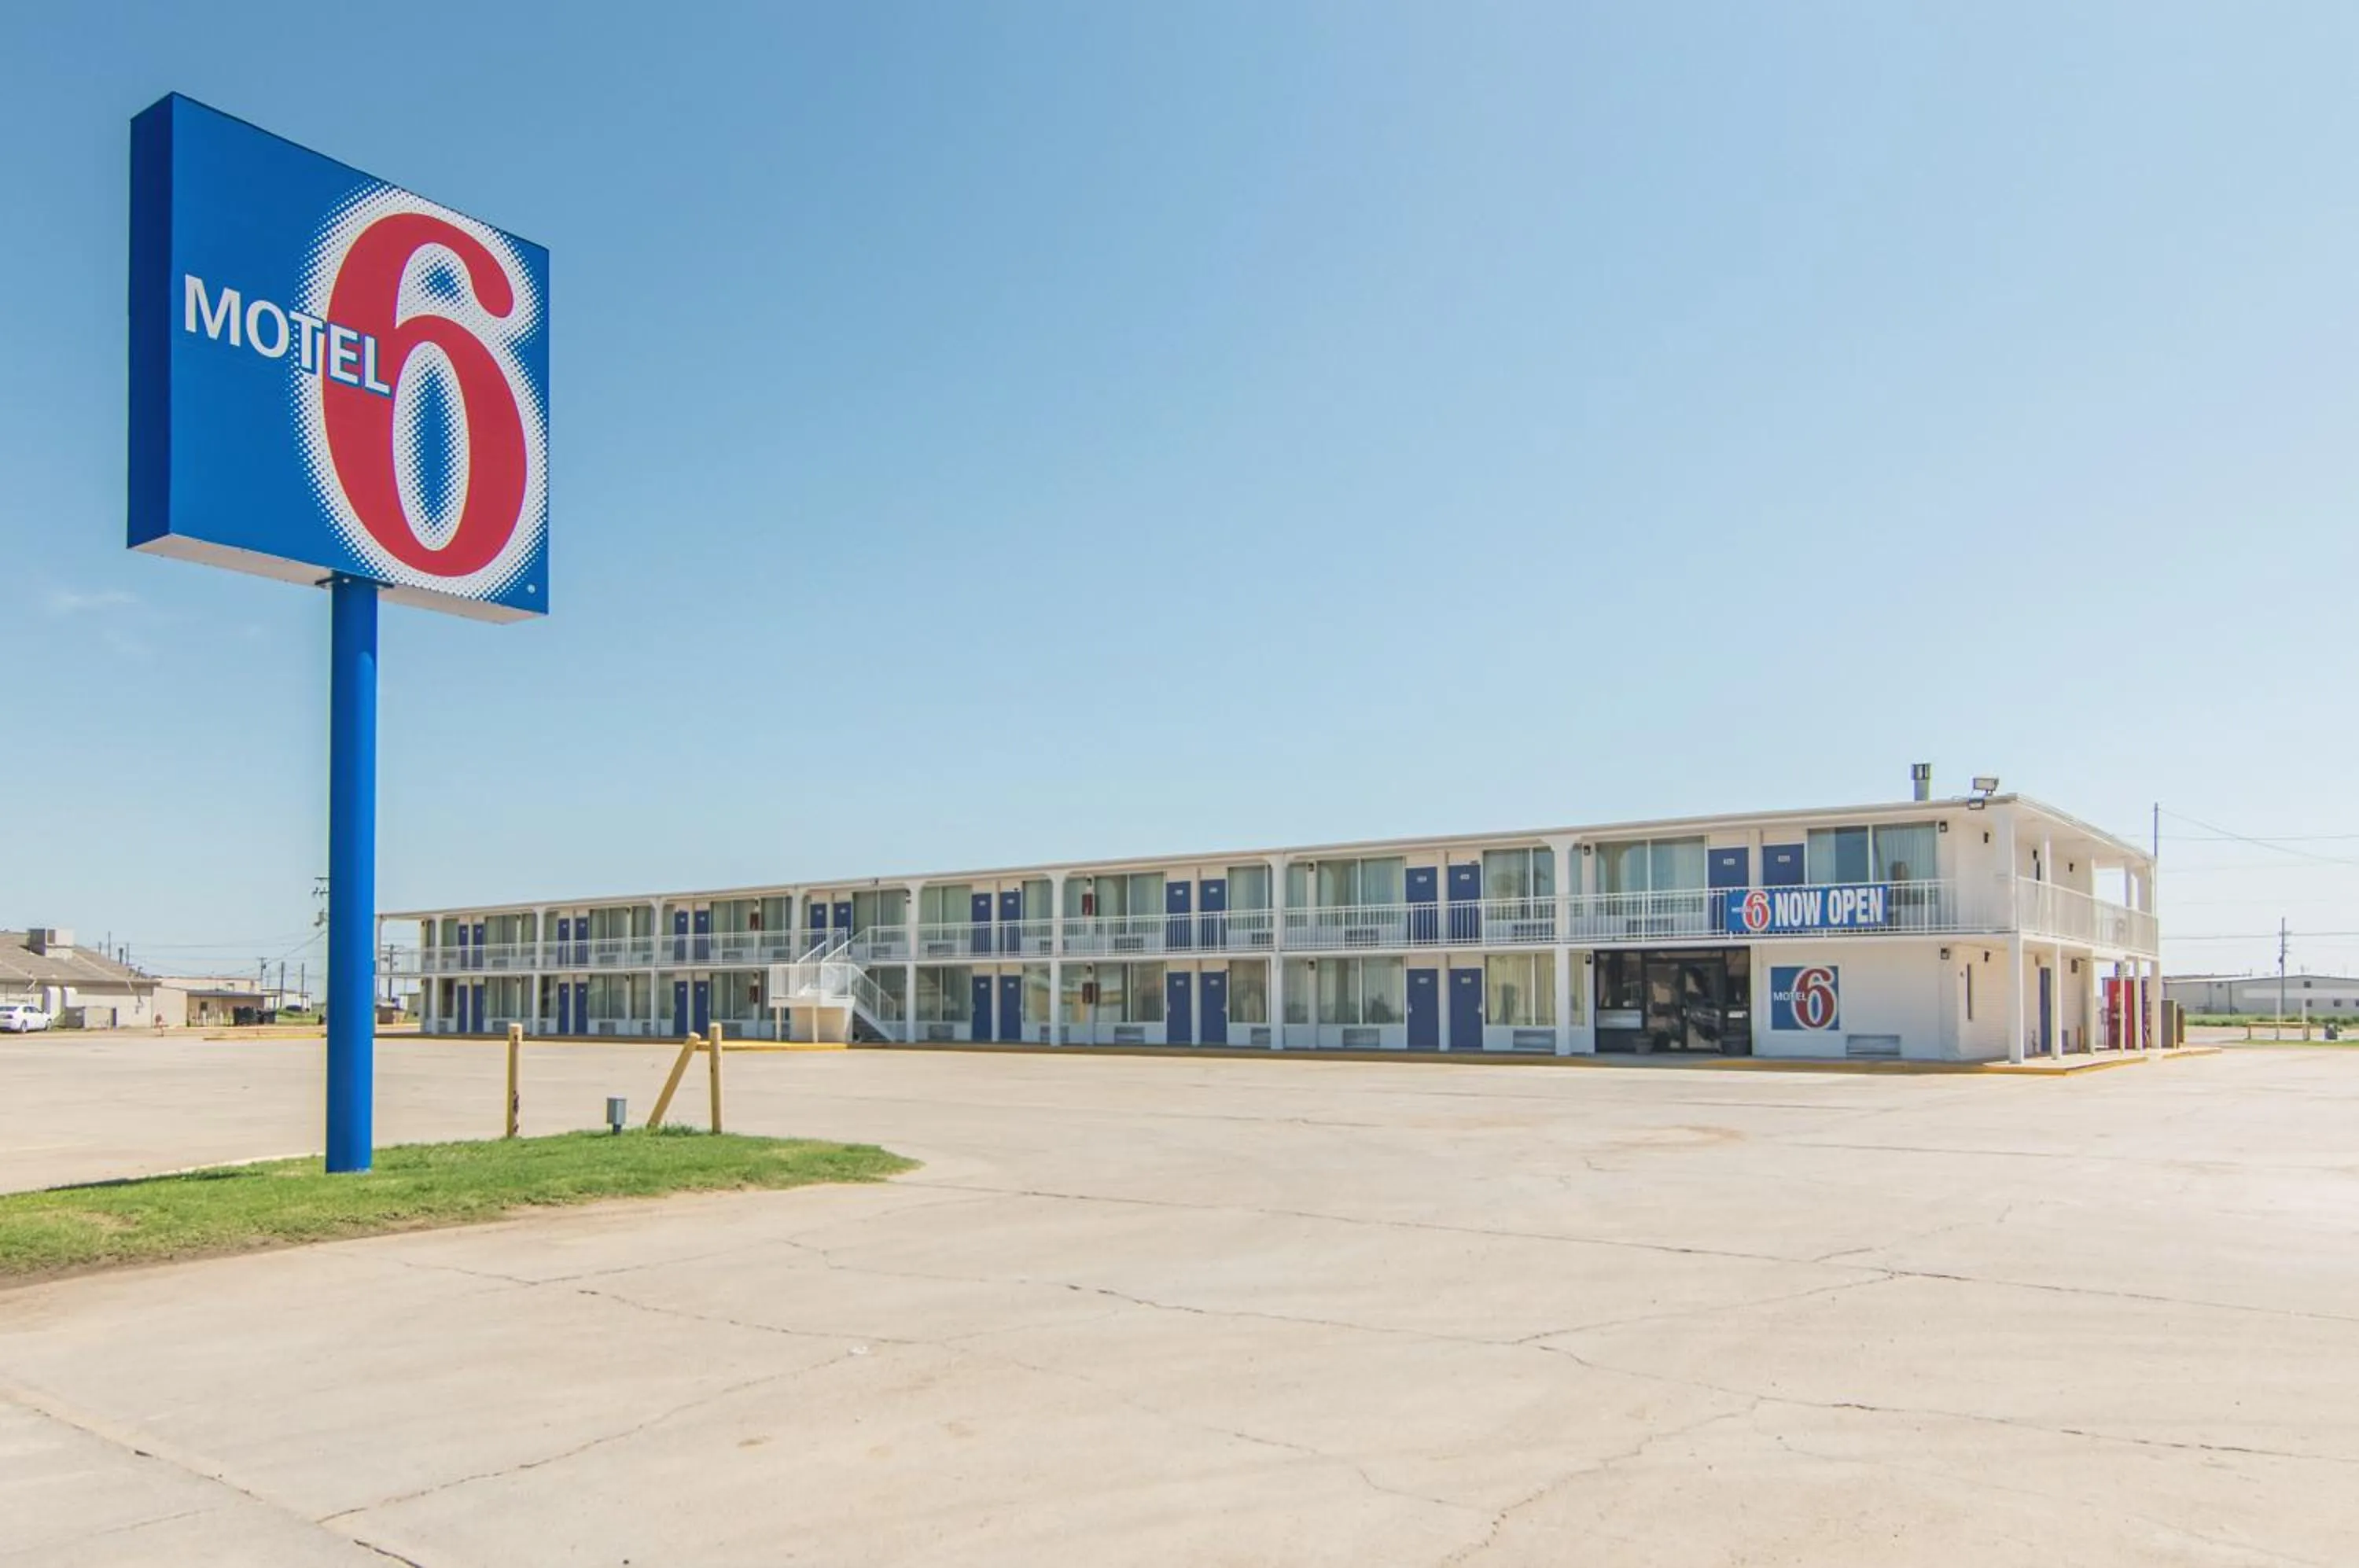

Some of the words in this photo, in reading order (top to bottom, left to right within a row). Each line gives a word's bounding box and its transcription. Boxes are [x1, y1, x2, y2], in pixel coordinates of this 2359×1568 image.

[185, 274, 390, 396] MOTEL
[322, 212, 528, 577] 6
[1743, 891, 1770, 930] 6
[1775, 892, 1822, 927] NOW
[1828, 888, 1882, 925] OPEN
[1773, 992, 1807, 1001] MOTEL
[1795, 968, 1835, 1029] 6
